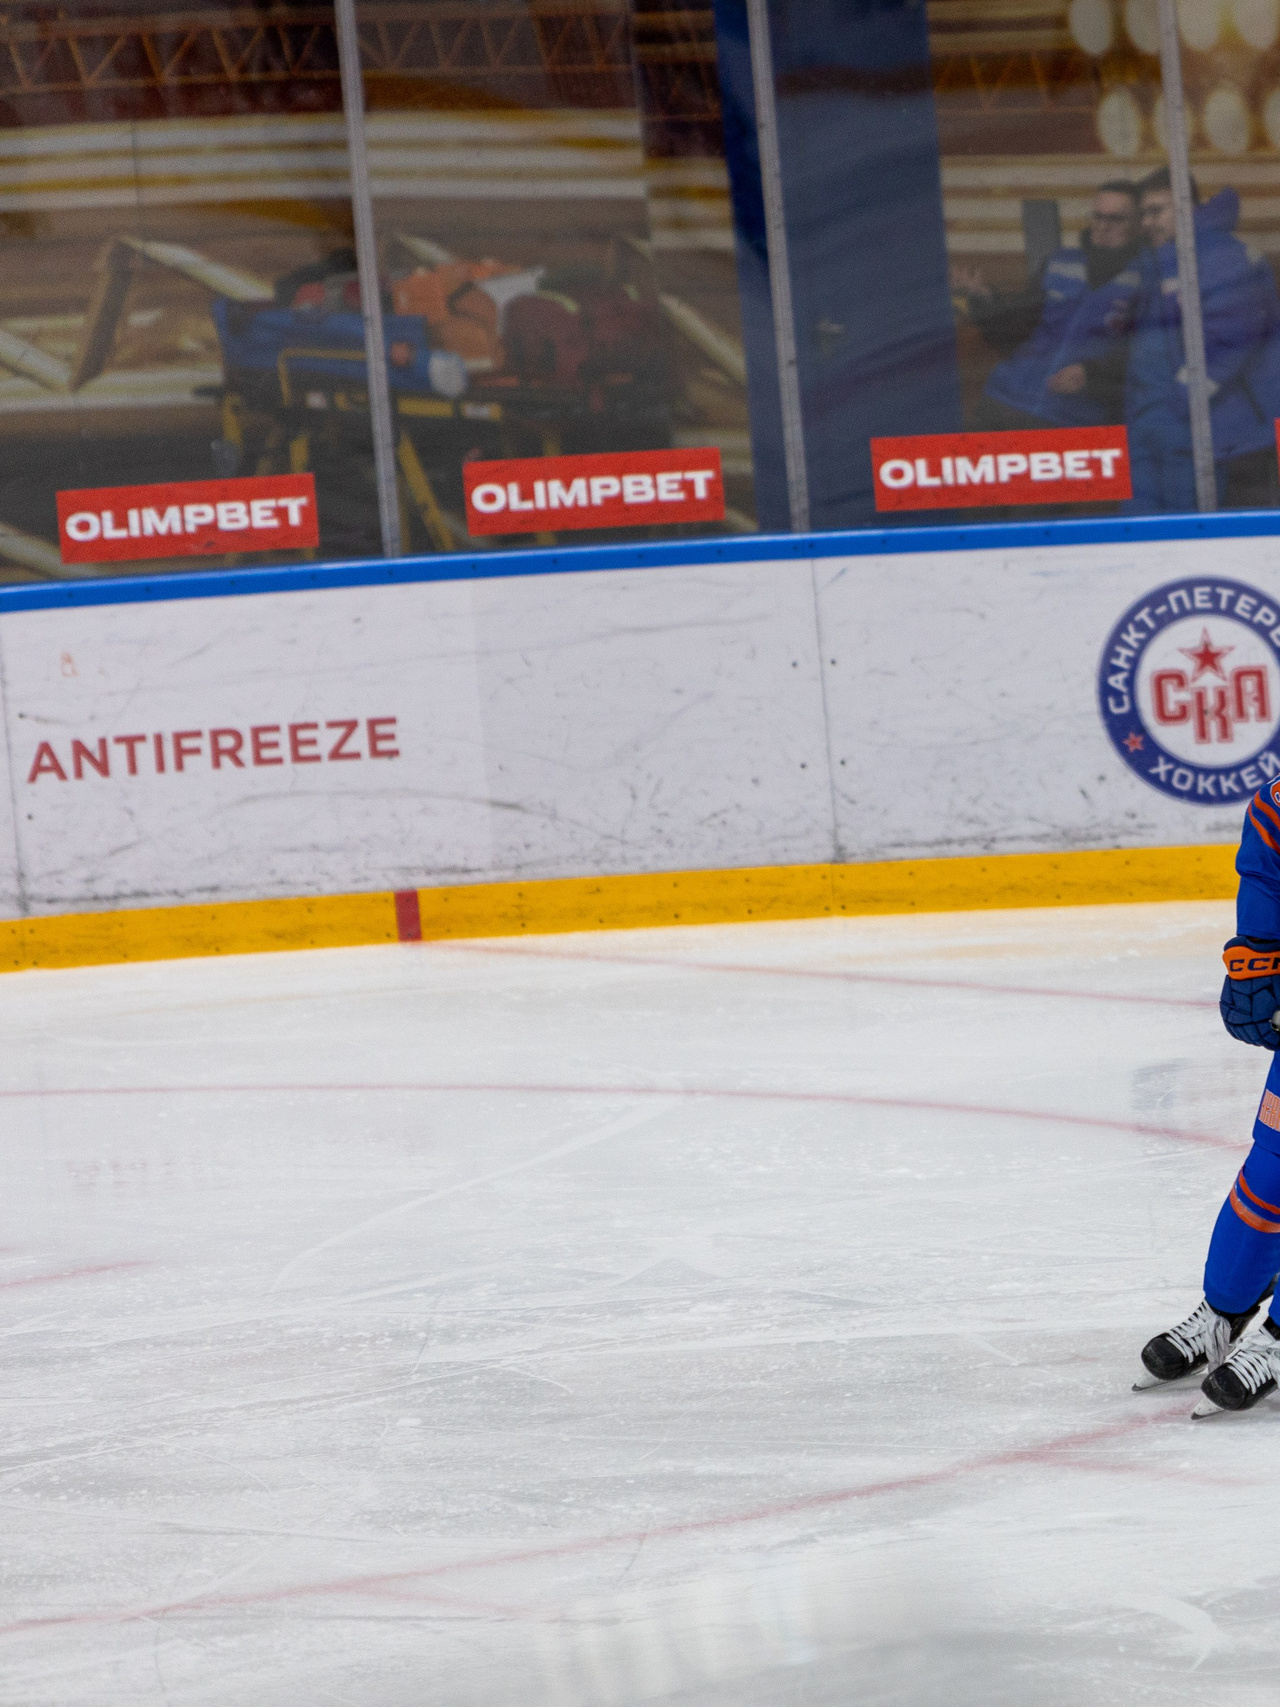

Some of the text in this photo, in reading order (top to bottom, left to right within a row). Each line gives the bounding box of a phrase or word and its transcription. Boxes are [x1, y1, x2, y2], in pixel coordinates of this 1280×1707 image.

[879, 449, 1121, 488] OLIMPBET
[471, 470, 714, 513] OLIMPBET
[66, 497, 308, 541] OLIMPBET
[1153, 664, 1272, 744] СКА
[27, 716, 400, 783] ANTIFREEZE
